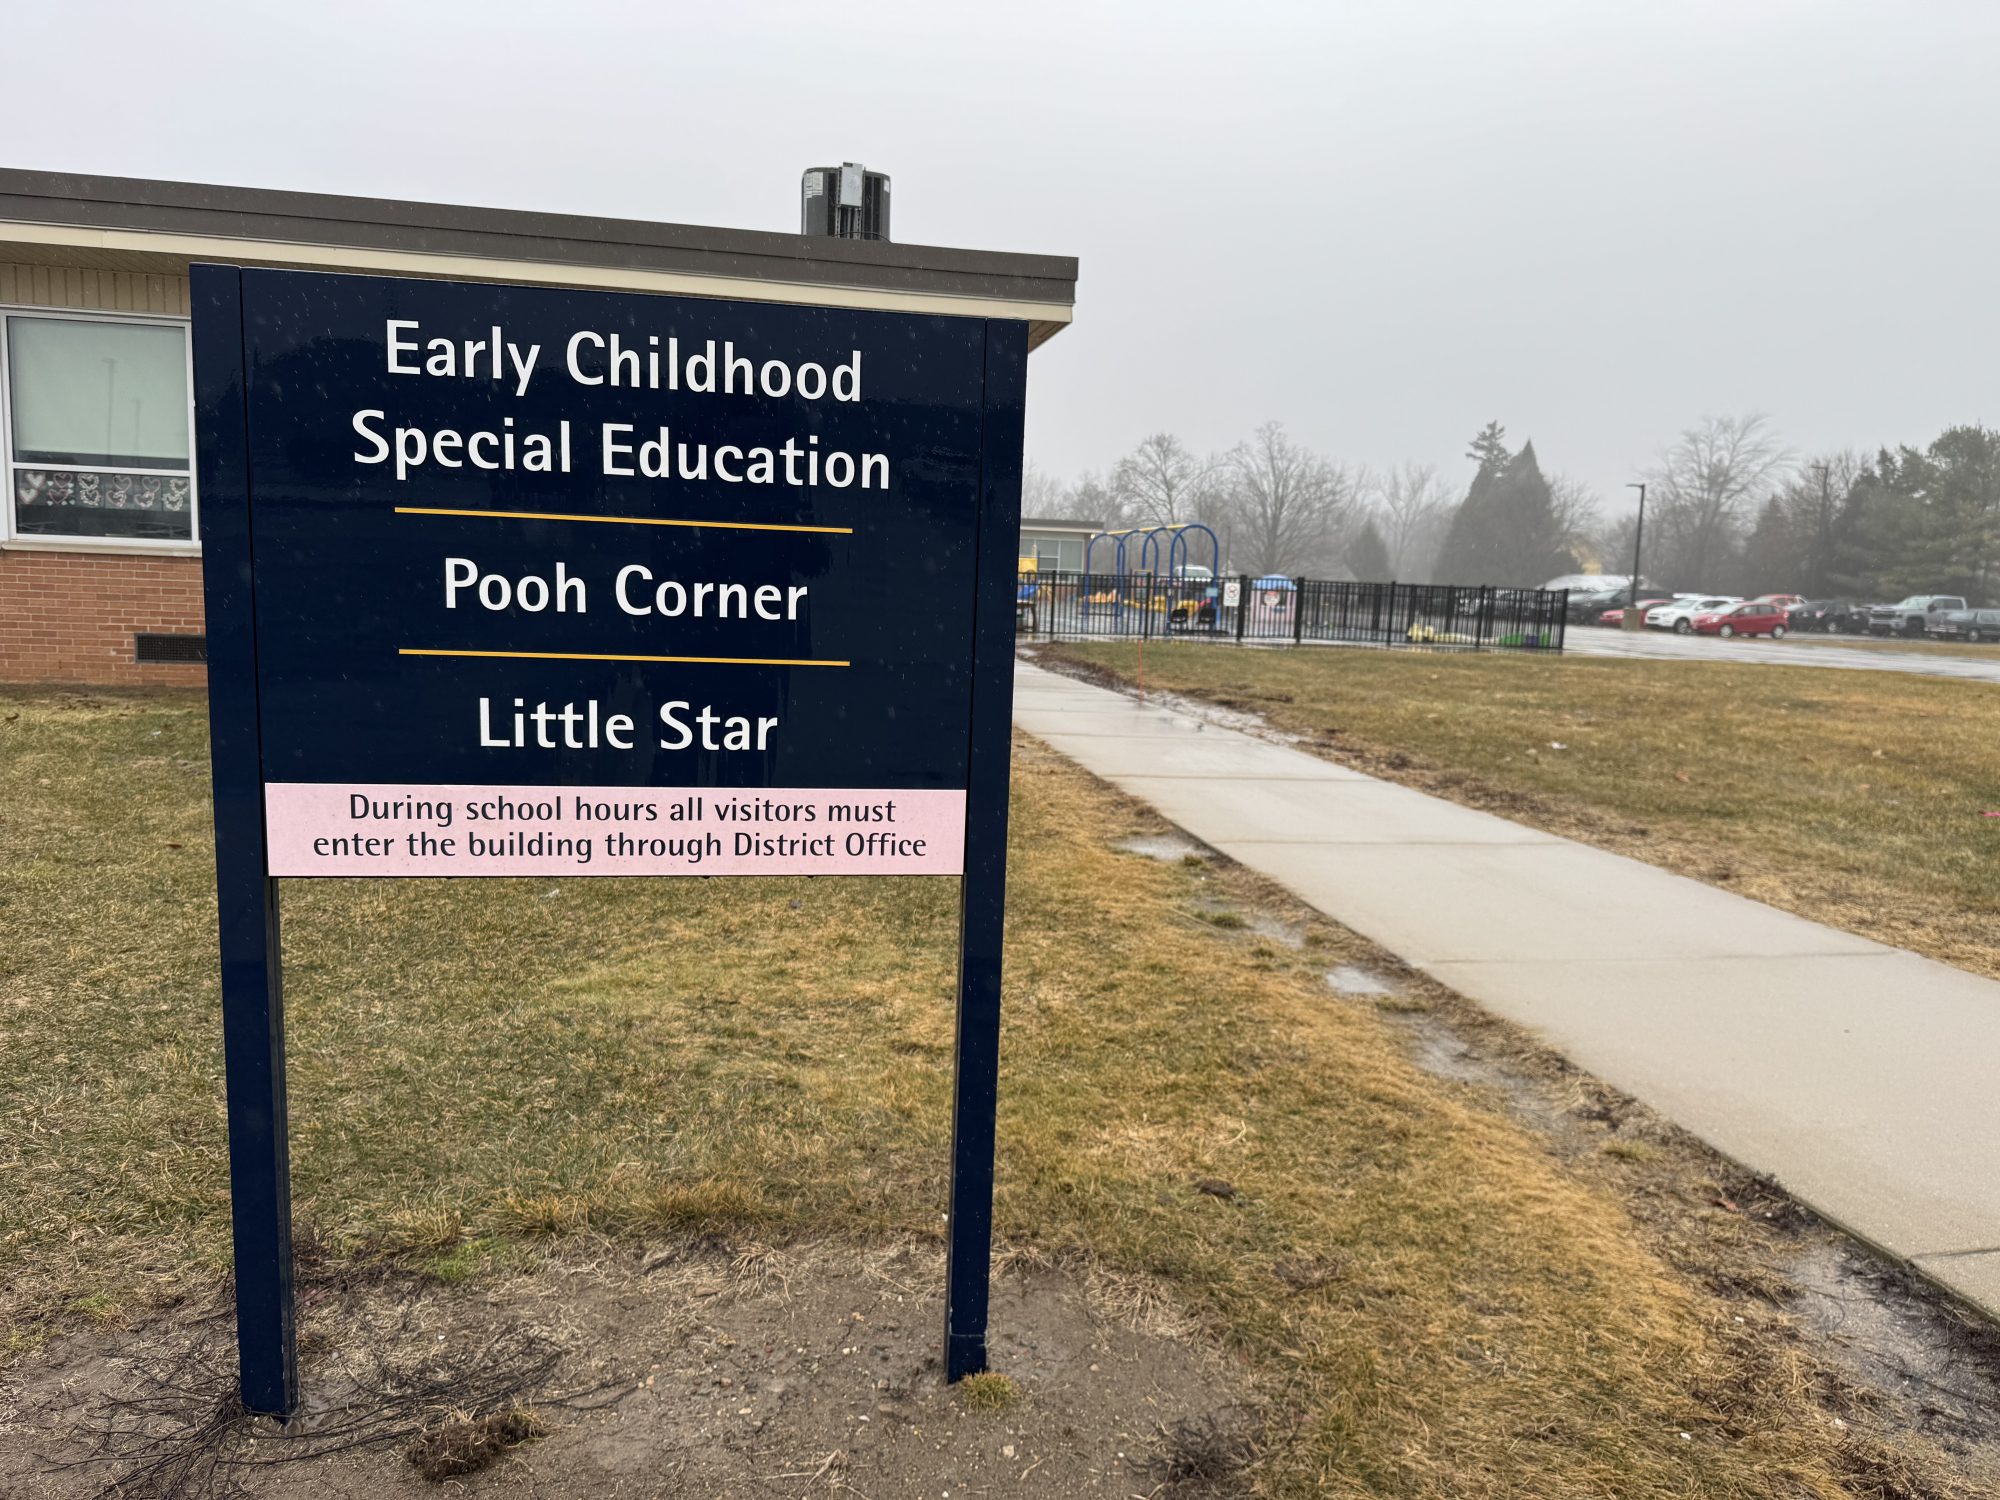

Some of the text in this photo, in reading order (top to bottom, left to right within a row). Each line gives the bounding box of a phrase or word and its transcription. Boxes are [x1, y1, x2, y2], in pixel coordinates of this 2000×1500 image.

[387, 320, 860, 401] Early Childhood
[353, 410, 889, 489] Special Education
[446, 558, 807, 620] Pooh Corner
[480, 698, 777, 750] Little Star
[351, 794, 896, 827] During school hours all visitors must
[314, 832, 926, 863] enter the building through District Office
